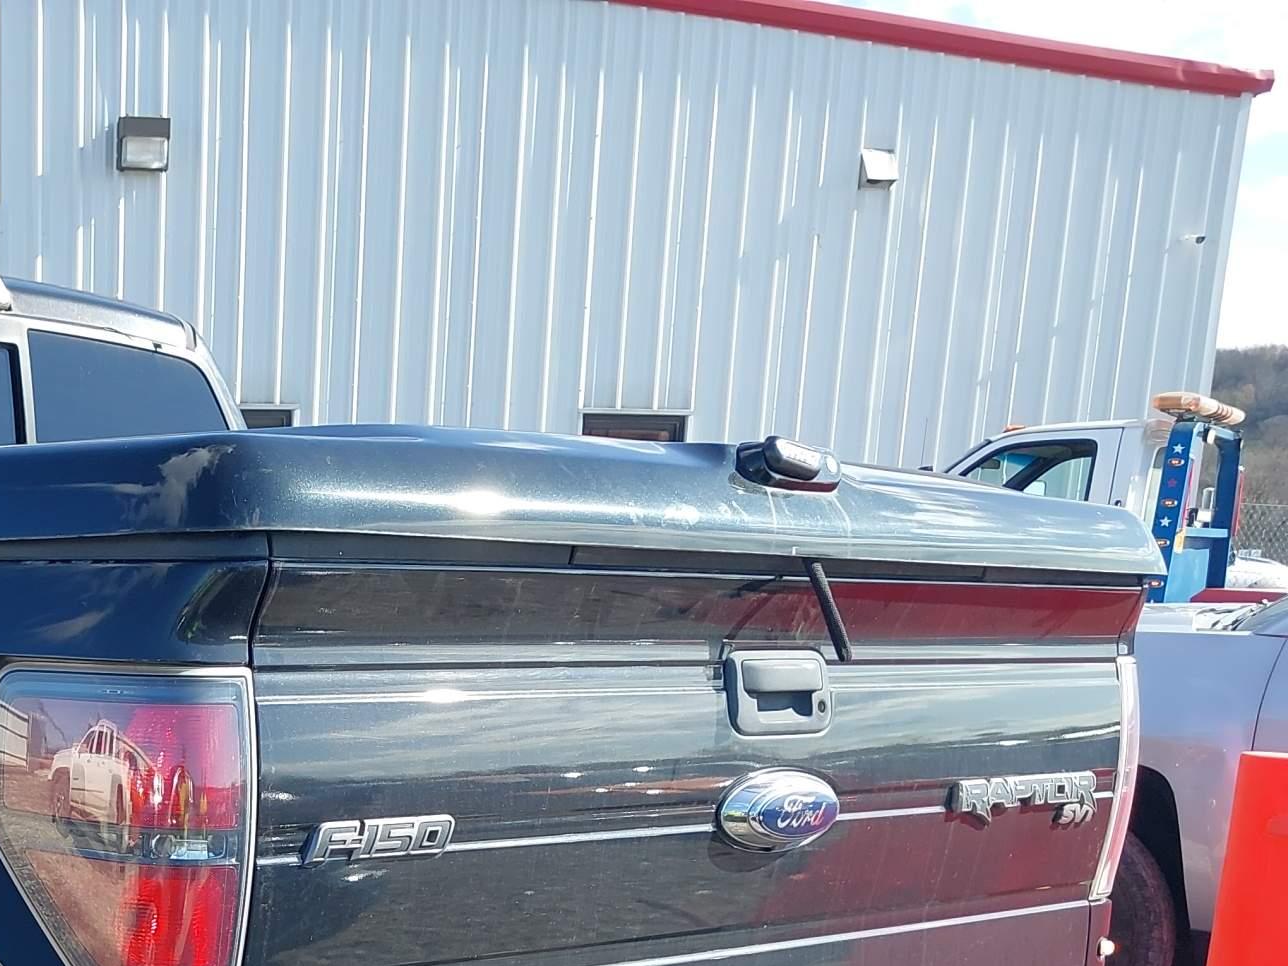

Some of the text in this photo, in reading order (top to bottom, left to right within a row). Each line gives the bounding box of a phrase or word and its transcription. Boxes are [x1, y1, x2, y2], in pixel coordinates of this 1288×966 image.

[776, 794, 827, 829] Ford
[958, 770, 1097, 824] RAPTOR
[310, 814, 456, 864] F-150
